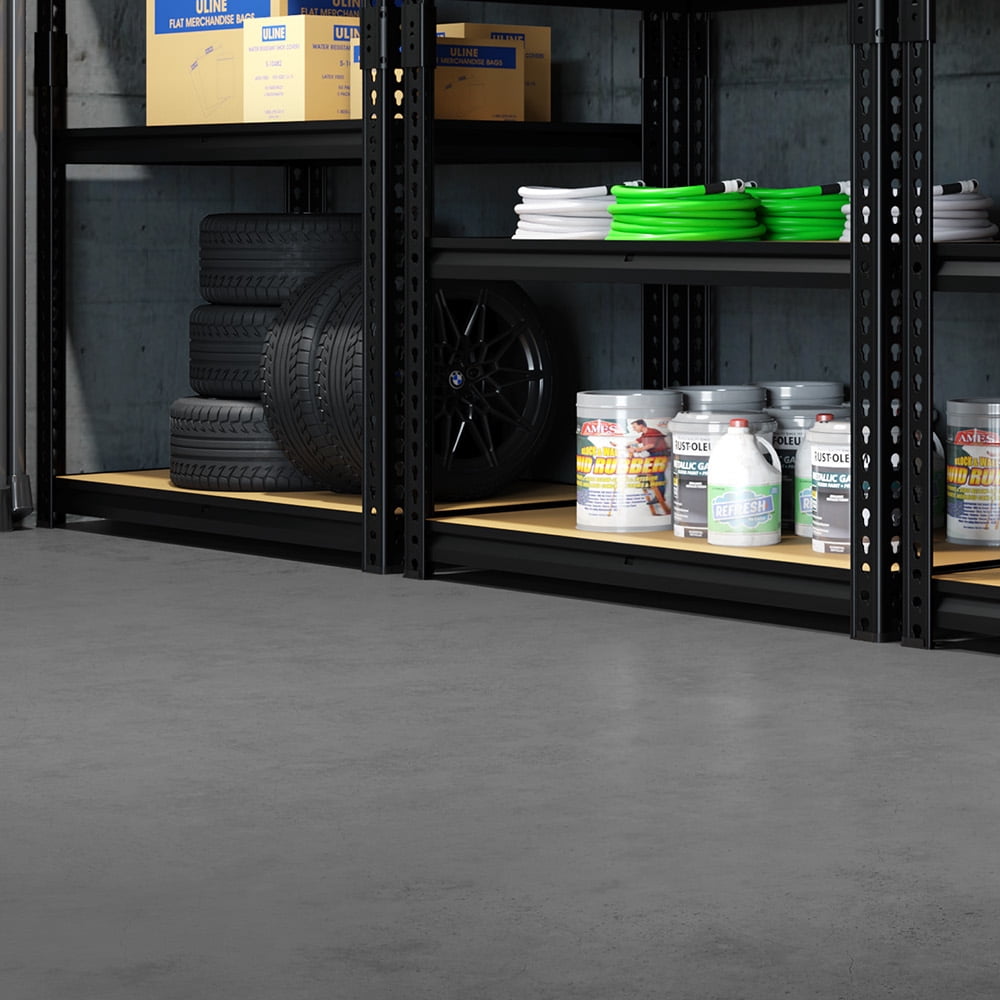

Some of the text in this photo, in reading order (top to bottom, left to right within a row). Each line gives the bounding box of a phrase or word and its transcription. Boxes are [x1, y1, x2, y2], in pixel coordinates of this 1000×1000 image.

[320, 8, 359, 17] MERCHAN
[169, 18, 184, 29] FLAT
[185, 15, 234, 27] MERCHANDISE
[262, 27, 286, 40] ULINE
[335, 27, 360, 39] ULIN
[450, 47, 478, 57] ULINE
[583, 423, 617, 434] AMES
[959, 433, 994, 443] AMES
[715, 502, 767, 517] REFRESH
